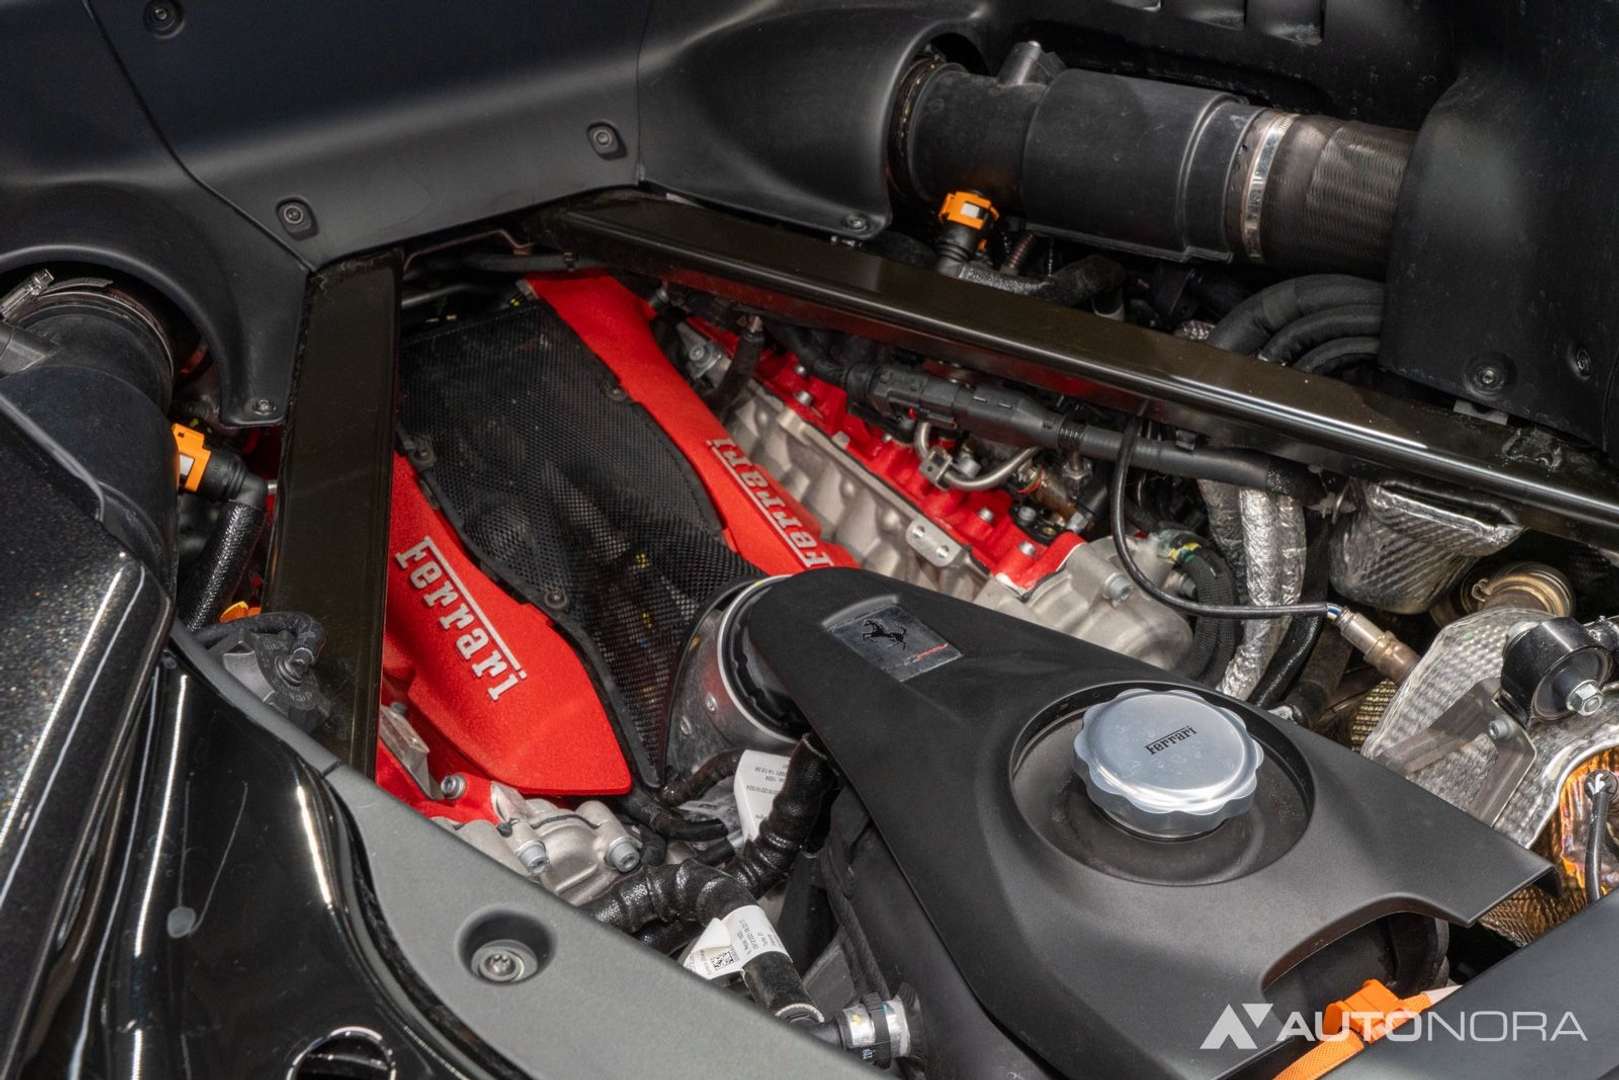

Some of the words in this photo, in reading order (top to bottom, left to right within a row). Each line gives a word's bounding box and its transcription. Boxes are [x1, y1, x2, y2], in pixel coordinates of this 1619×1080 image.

[706, 437, 835, 568] Ferrari
[395, 536, 528, 701] Ferrari
[1144, 725, 1197, 755] Ferrari
